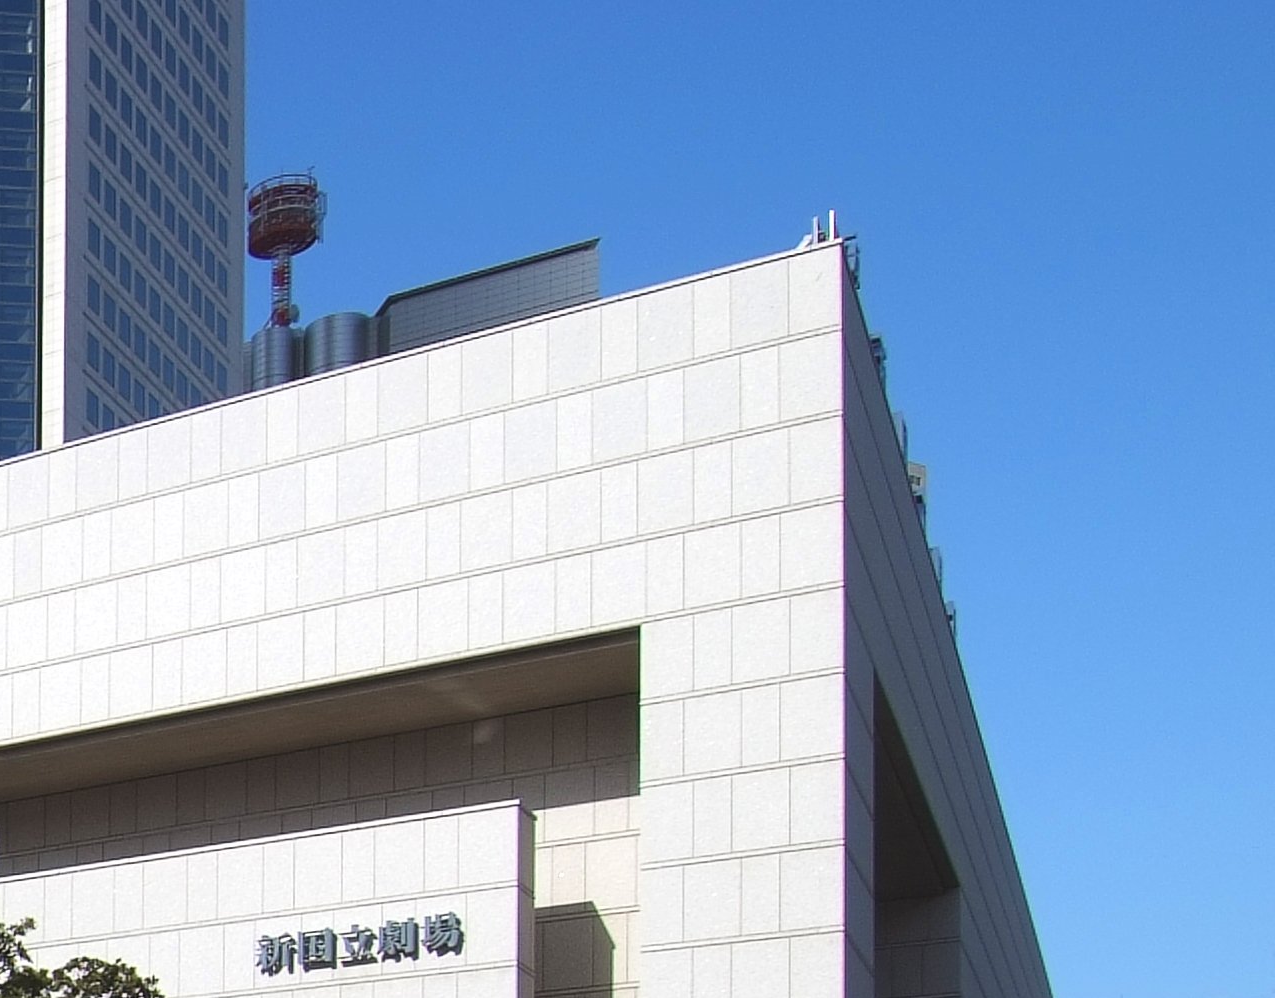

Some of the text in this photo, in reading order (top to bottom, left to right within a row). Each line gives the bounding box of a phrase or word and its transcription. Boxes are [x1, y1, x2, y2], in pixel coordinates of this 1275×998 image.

[256, 912, 463, 974] 新国立劇場
